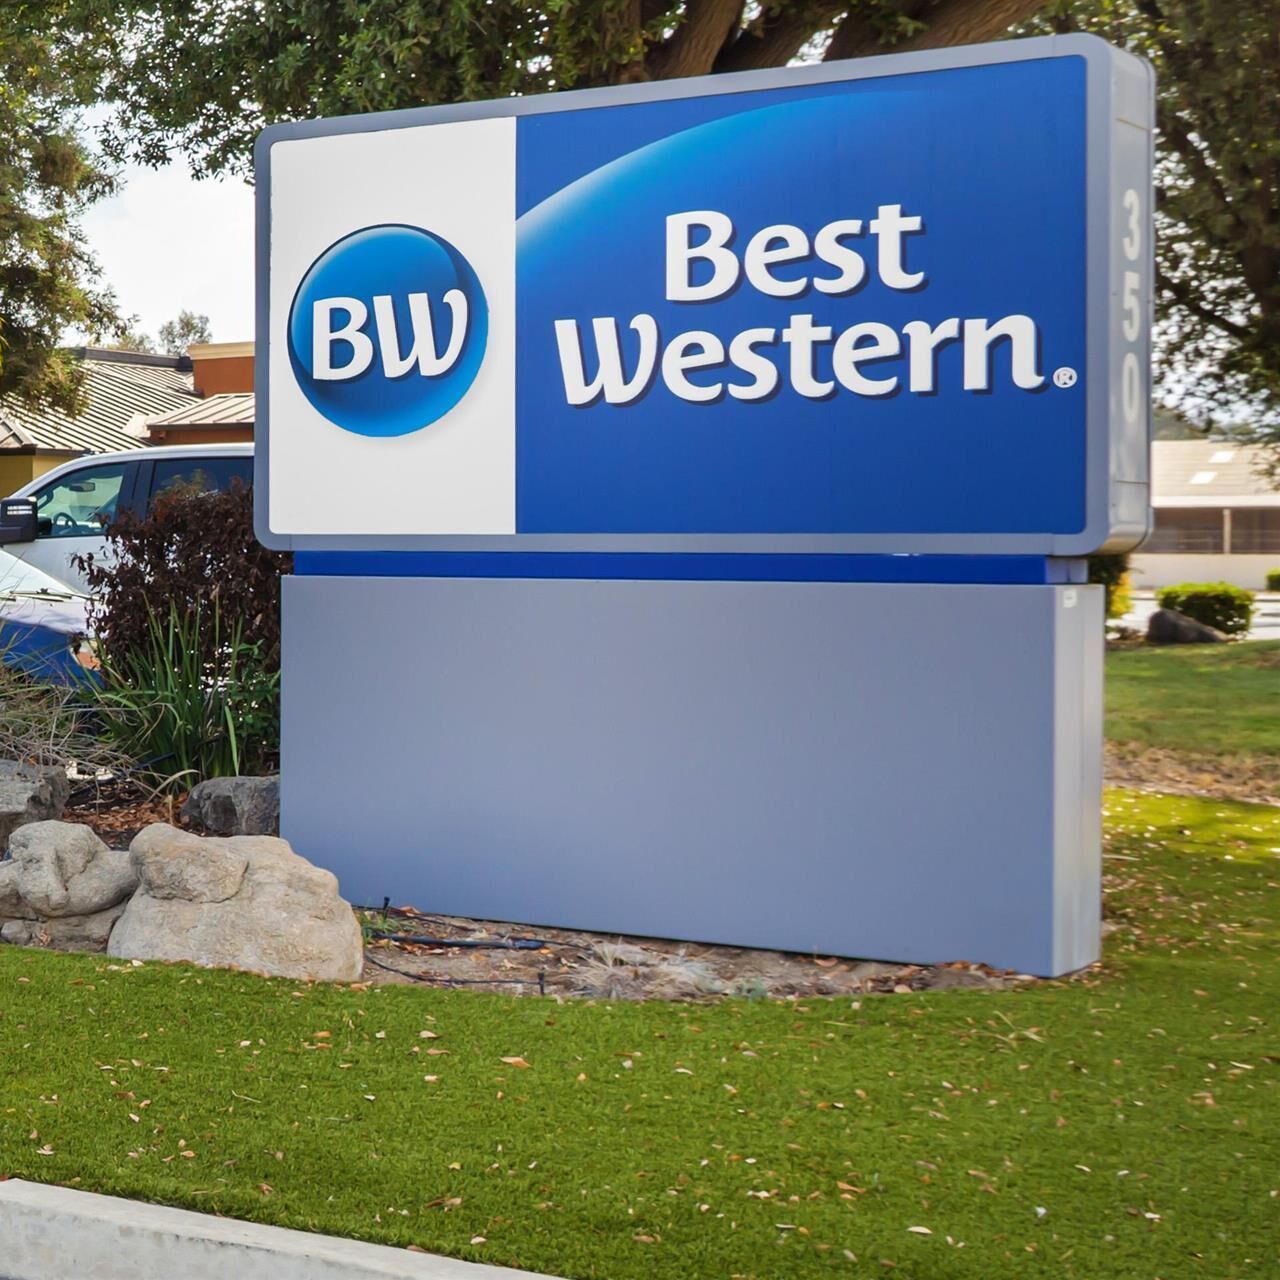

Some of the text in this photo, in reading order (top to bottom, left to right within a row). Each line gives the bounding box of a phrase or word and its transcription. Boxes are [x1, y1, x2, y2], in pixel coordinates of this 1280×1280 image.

[665, 204, 925, 302] Best
[312, 288, 468, 381] BW
[1122, 188, 1140, 421] 350
